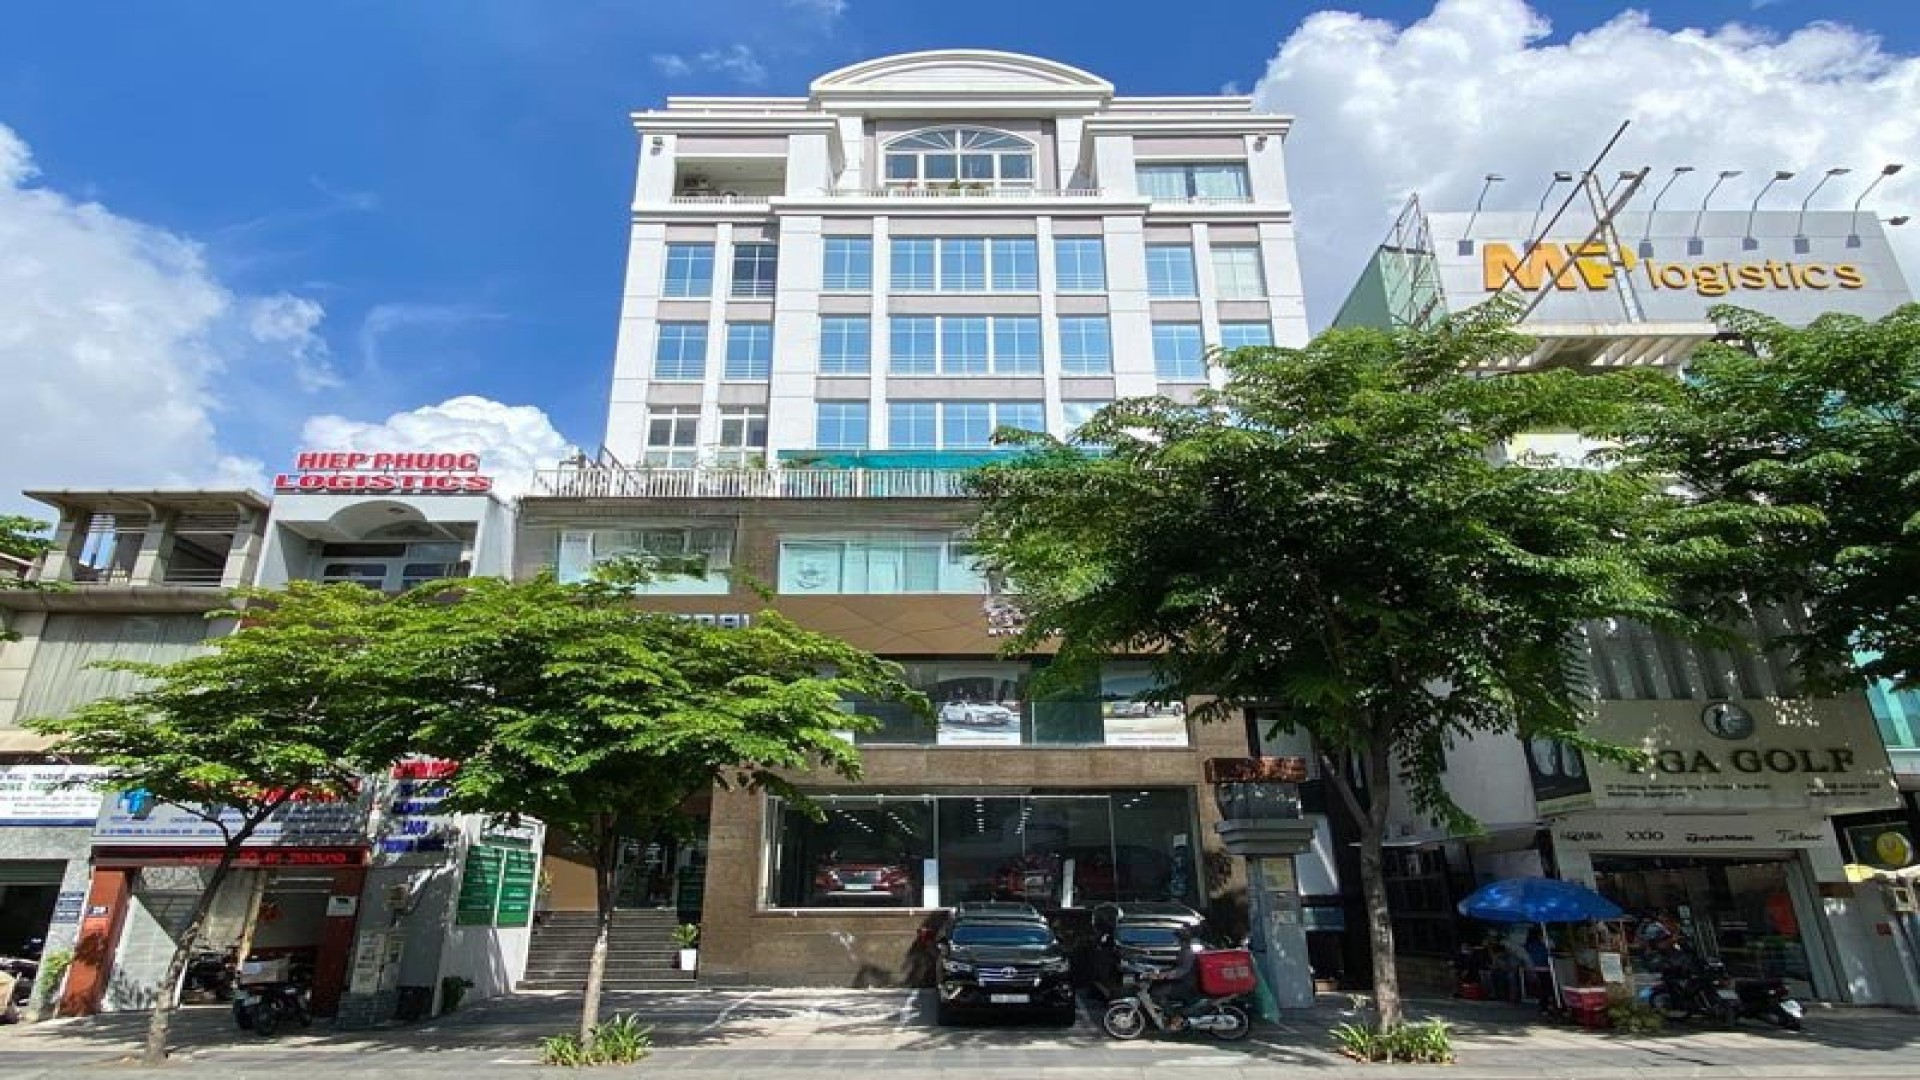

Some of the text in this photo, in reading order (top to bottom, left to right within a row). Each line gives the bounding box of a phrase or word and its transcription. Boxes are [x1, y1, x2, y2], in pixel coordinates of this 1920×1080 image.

[1645, 258, 1864, 297] logistics
[297, 452, 481, 470] HIEP PHUOC
[275, 474, 493, 491] LOGISTICS
[1730, 748, 1855, 774] GOLF
